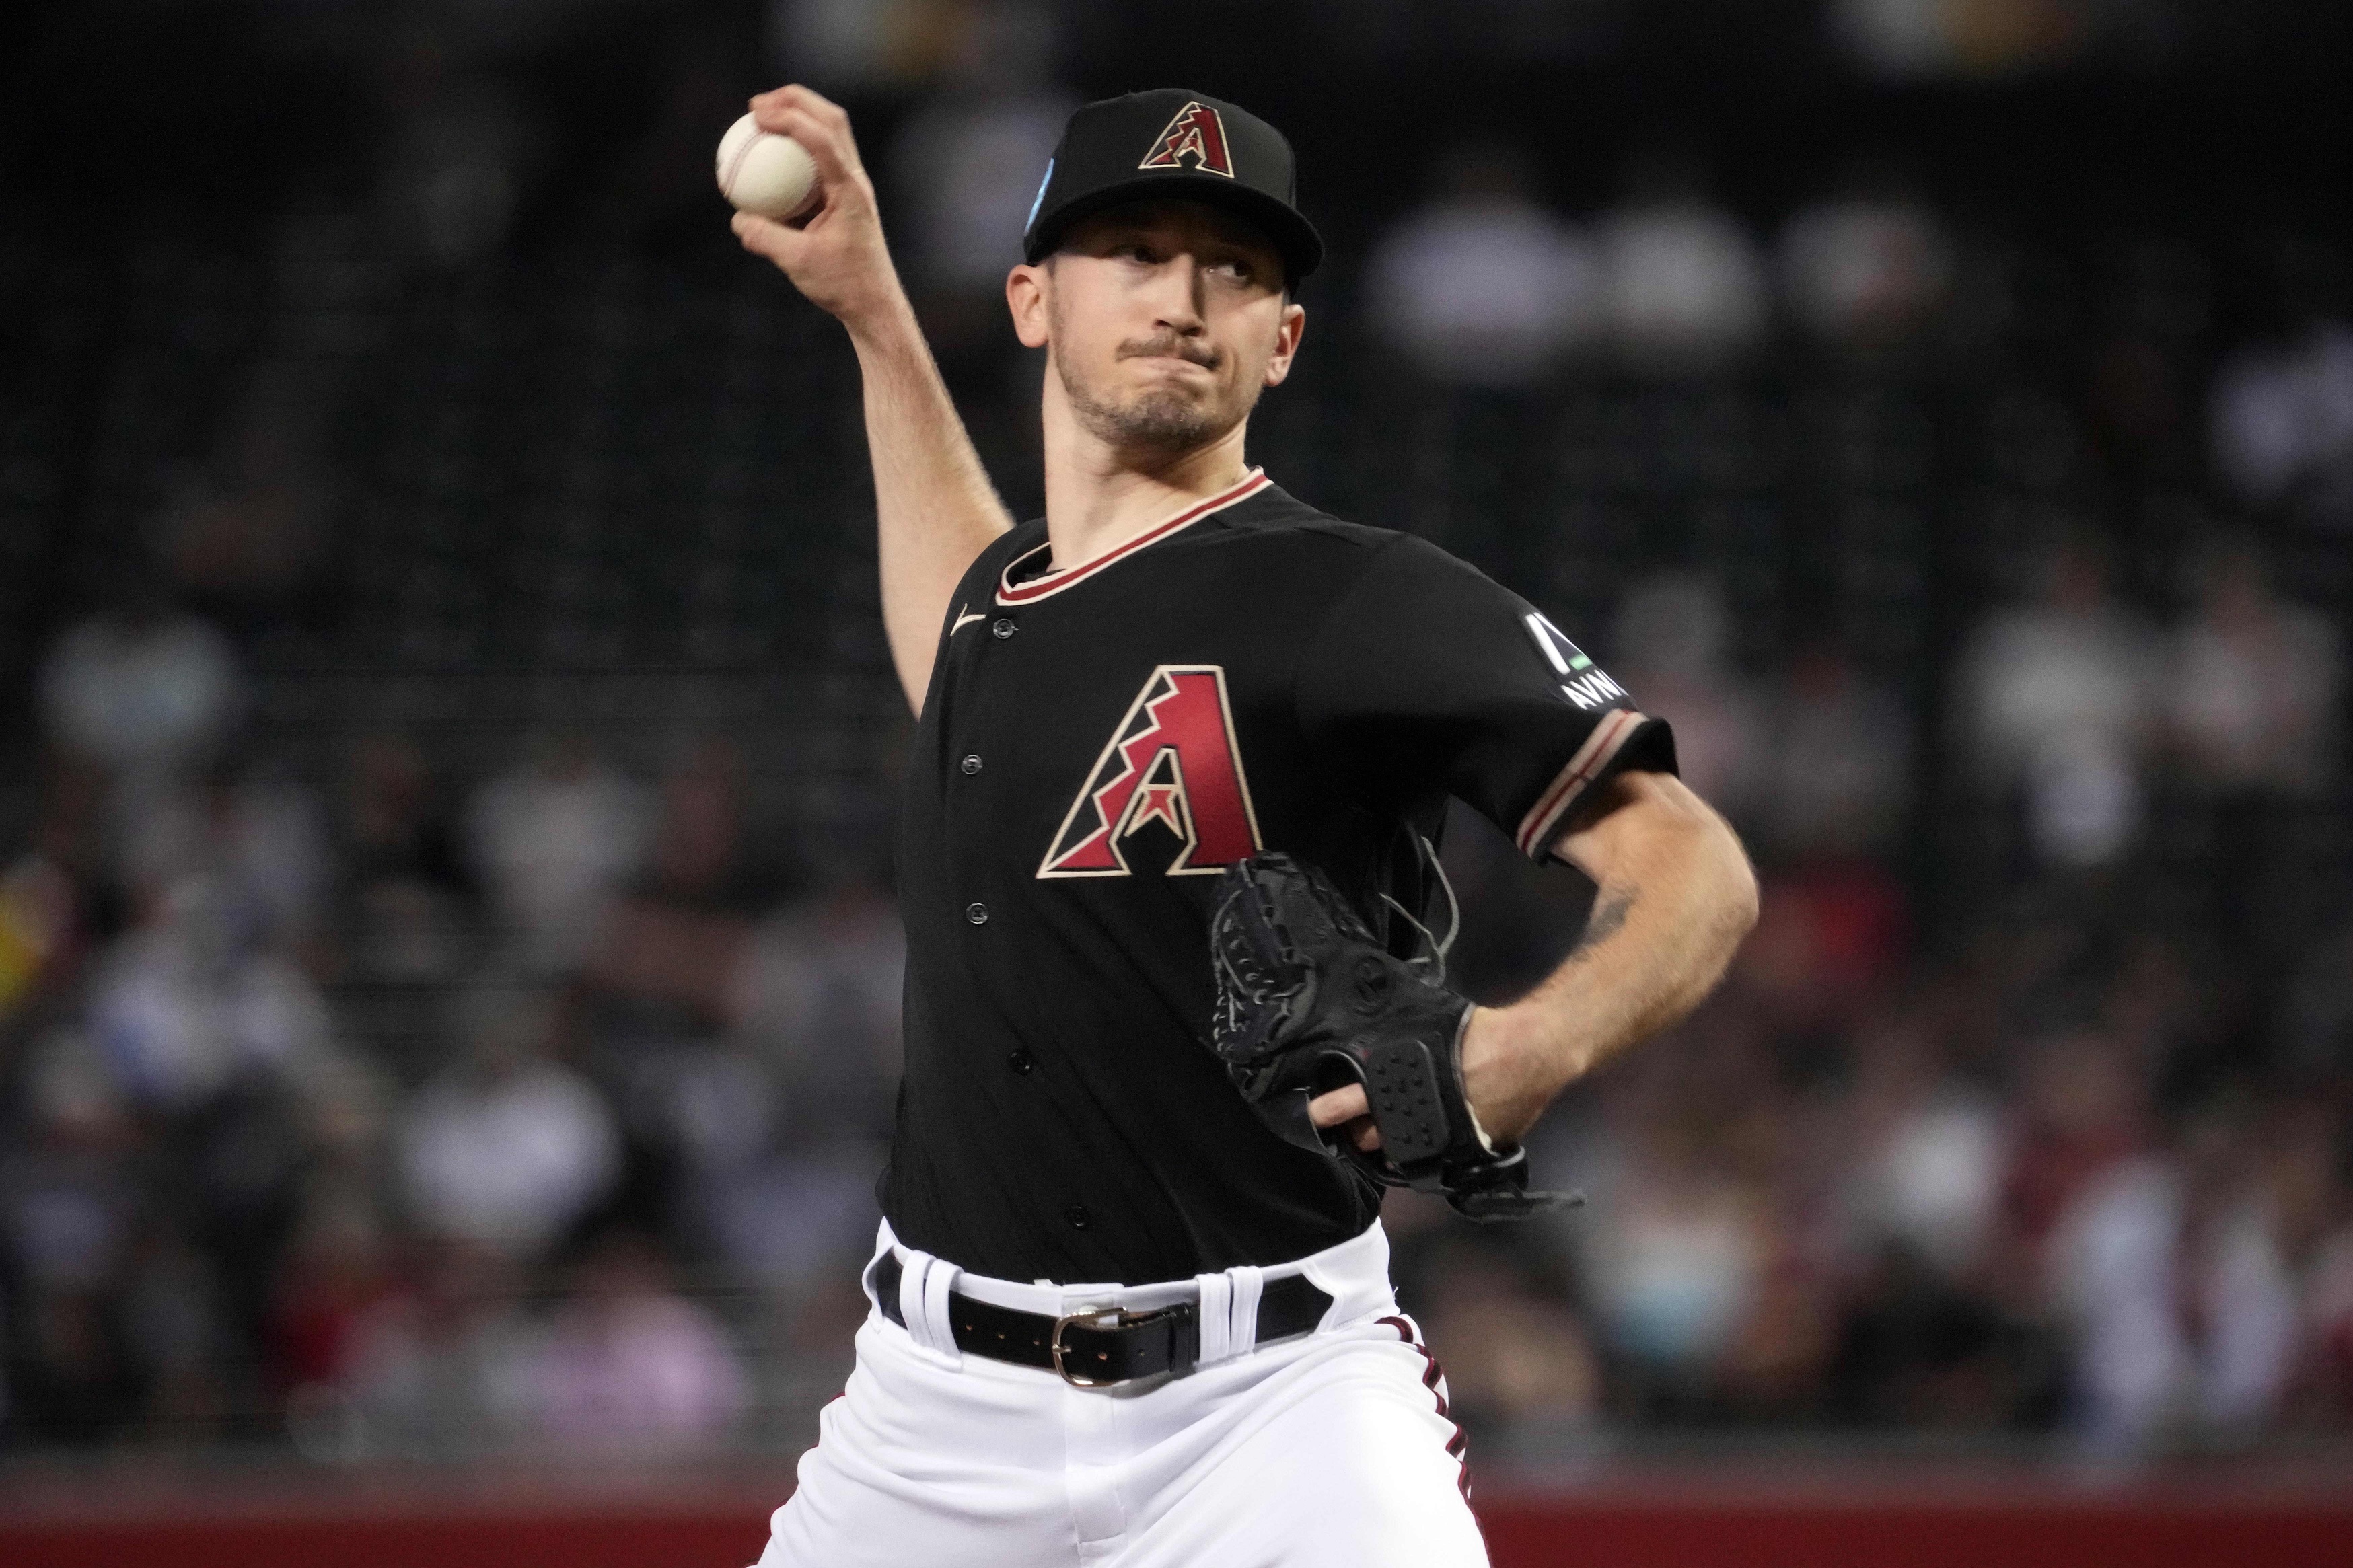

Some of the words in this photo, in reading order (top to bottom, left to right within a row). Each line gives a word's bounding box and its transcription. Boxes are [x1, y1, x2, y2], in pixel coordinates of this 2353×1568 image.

[1138, 101, 1235, 178] A
[1560, 669, 1629, 710] AVN
[1036, 665, 1264, 879] A
